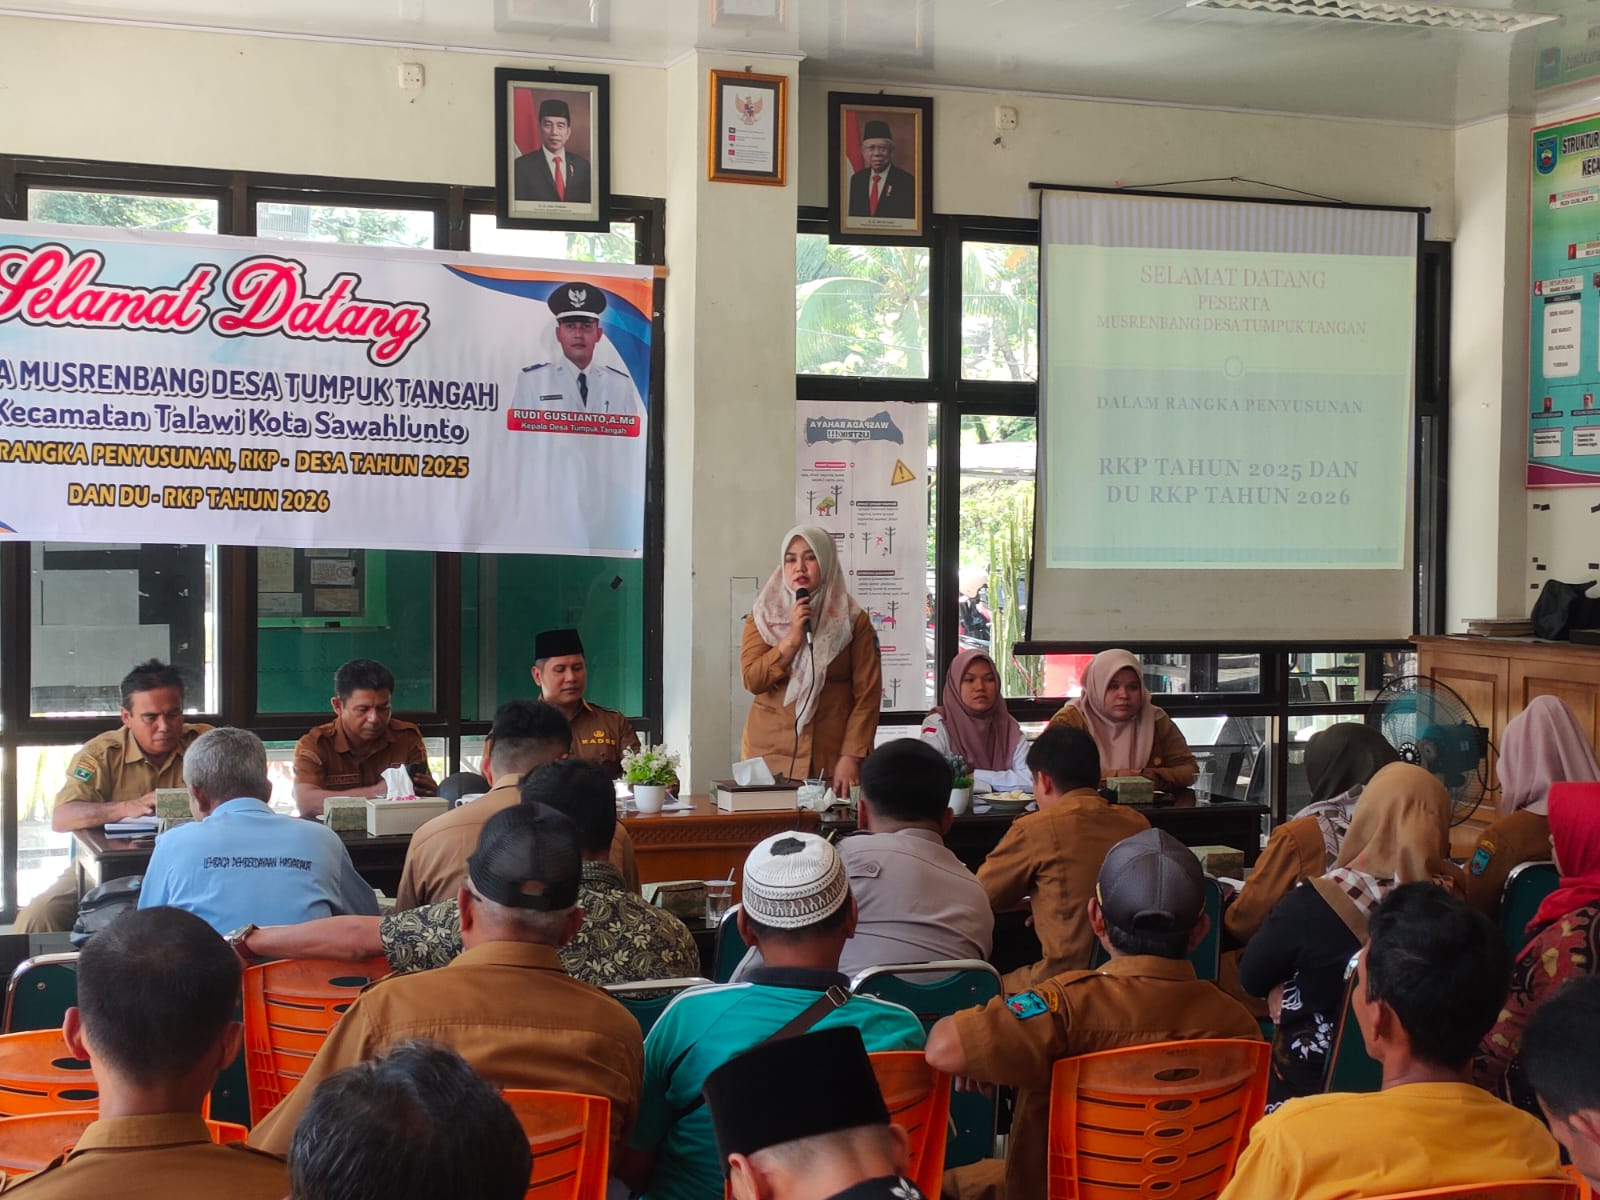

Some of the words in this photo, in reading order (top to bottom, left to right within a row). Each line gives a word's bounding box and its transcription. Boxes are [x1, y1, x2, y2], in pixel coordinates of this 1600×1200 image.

[1140, 264, 1238, 287] SELAMAT
[1243, 268, 1326, 289] DATANG
[0, 243, 214, 332] Selamat
[211, 256, 428, 365] Datang
[1198, 295, 1271, 312] PESERTA
[1097, 314, 1200, 331] MUSRENBANG
[1203, 316, 1240, 332] DESA
[1241, 318, 1304, 334] TUMPUK
[20, 360, 207, 394] MUSRENBANG
[211, 369, 278, 397] DESA
[285, 372, 392, 401] TUMPUK
[396, 378, 496, 408] TANGAH
[513, 409, 540, 419] RUDI
[1096, 395, 1159, 410] DALAM
[1165, 396, 1240, 412] RANGKA
[1245, 398, 1364, 415] PENYUSUNAN
[154, 404, 245, 431] Talawi
[250, 408, 308, 434] Kota
[315, 411, 466, 441] Sawahlunto
[521, 421, 547, 431] Kepala
[549, 422, 568, 431] Desa
[571, 423, 598, 433] Tumpuk
[600, 425, 627, 435] Tangah
[0, 439, 89, 465] RANGKA
[91, 443, 236, 472] PENYUSUNAN,
[295, 451, 347, 474] DESA
[350, 452, 419, 476] TAHUN
[422, 455, 469, 478] 2025
[1098, 456, 1148, 476] RKP
[1154, 457, 1242, 478] TAHUN
[1249, 463, 1303, 481] 2025
[1309, 460, 1359, 479] DAN
[68, 483, 116, 506] DAN
[207, 487, 278, 510] TAHUN
[281, 490, 330, 512] 2026
[1106, 485, 1140, 504] DU
[1149, 485, 1198, 504] RKP
[1204, 485, 1291, 505] TAHUN
[1297, 486, 1351, 505] 2026
